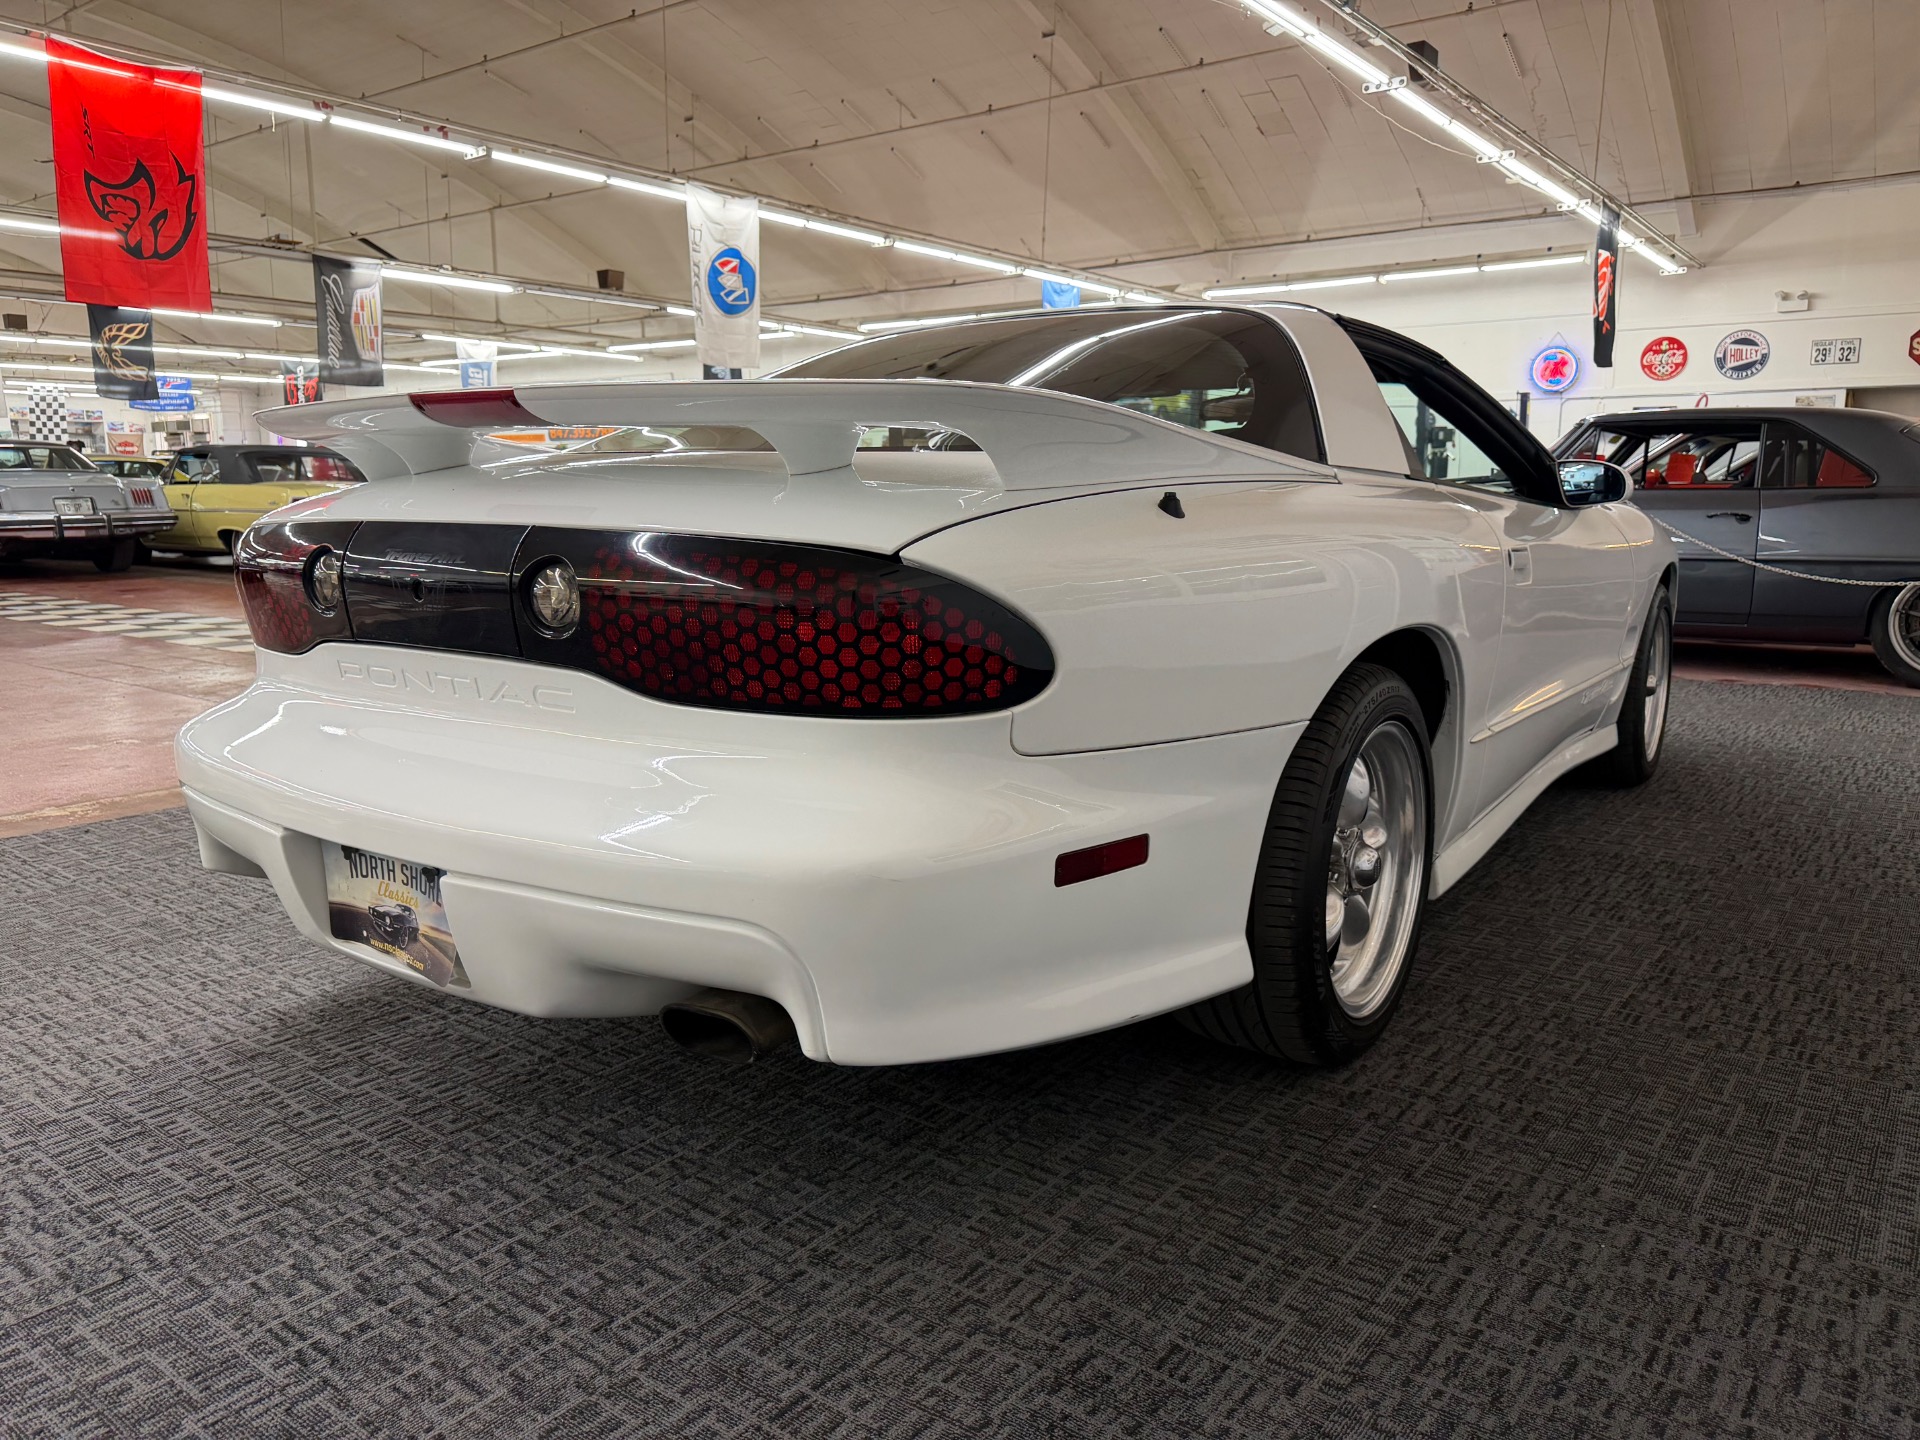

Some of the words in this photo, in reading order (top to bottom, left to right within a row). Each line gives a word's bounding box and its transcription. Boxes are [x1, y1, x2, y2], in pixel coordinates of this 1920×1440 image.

[80, 102, 96, 160] SRT
[321, 274, 345, 369] Cadillac
[1729, 347, 1760, 364] HOLLEY
[337, 660, 576, 714] PONTIAC
[349, 852, 396, 883] NORTH
[378, 880, 420, 908] Classics
